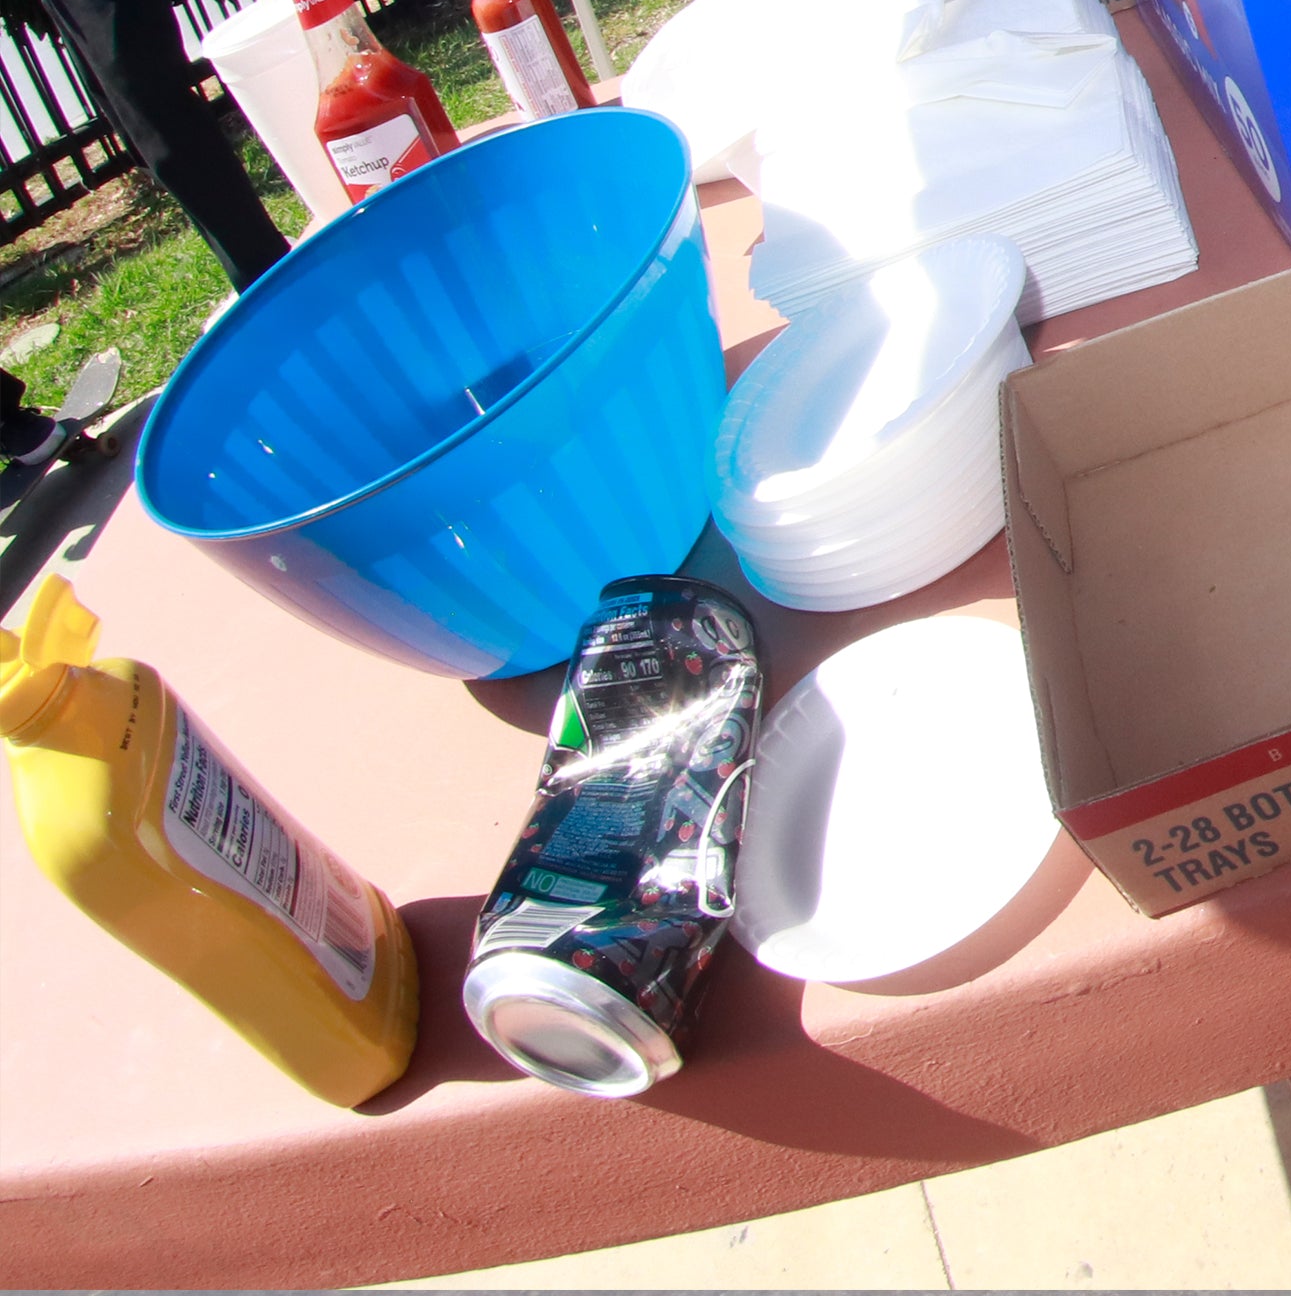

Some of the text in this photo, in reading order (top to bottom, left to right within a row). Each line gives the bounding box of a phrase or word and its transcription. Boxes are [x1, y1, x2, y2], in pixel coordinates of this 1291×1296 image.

[341, 157, 390, 179] Ketchup
[640, 658, 659, 675] 170
[168, 789, 182, 814] First
[176, 762, 188, 789] Street
[184, 744, 209, 828] Nutrition Facts
[232, 808, 250, 867] Calories
[1132, 816, 1221, 868] 2-28
[1153, 831, 1280, 894] TRAYS
[523, 869, 556, 894] NO
